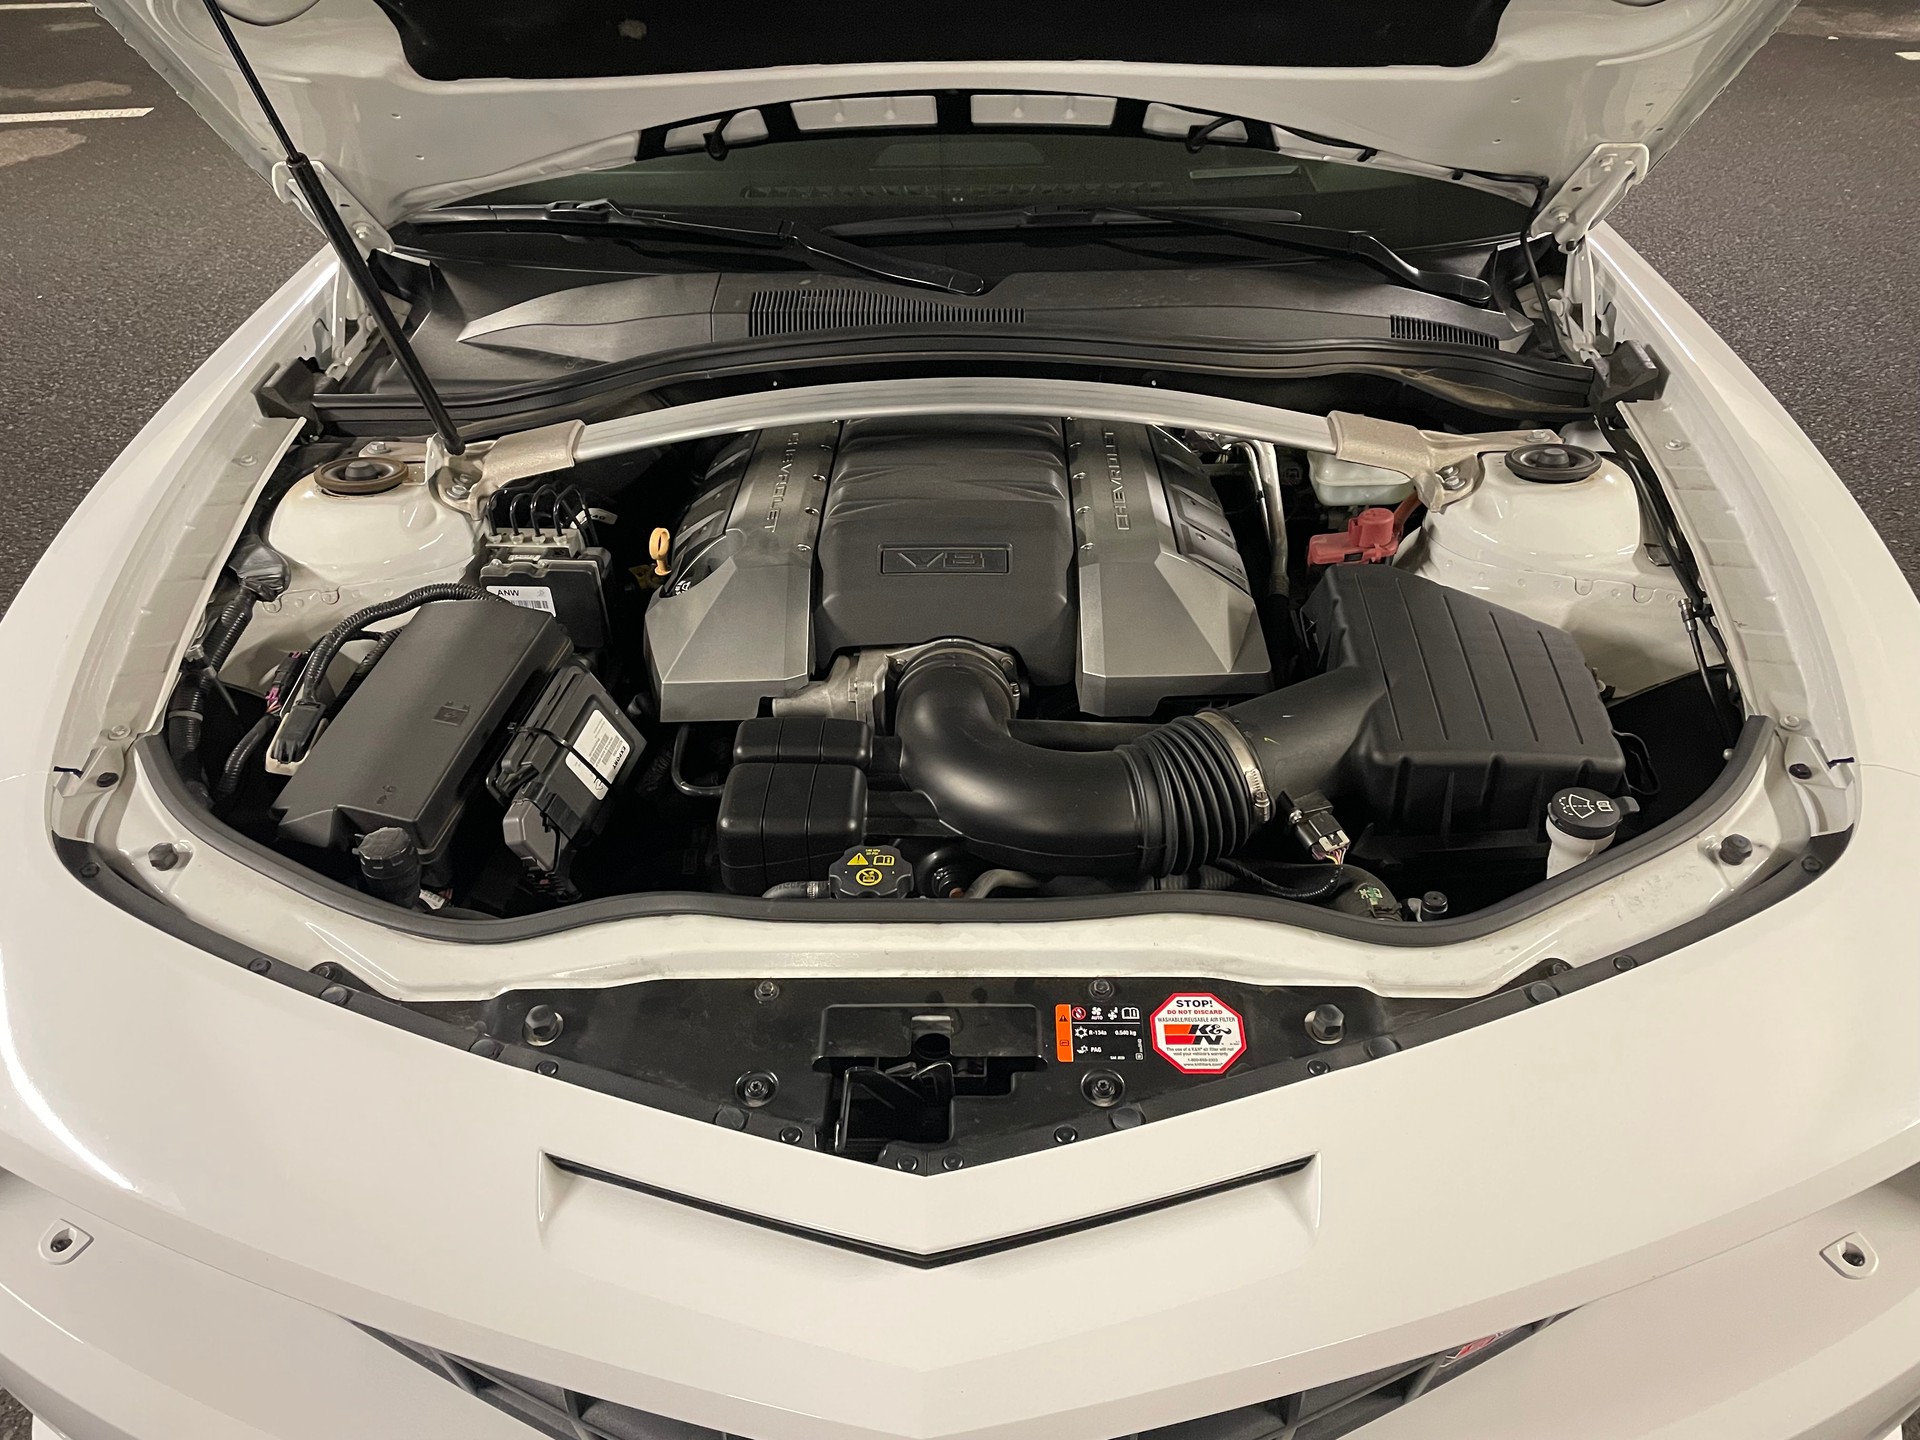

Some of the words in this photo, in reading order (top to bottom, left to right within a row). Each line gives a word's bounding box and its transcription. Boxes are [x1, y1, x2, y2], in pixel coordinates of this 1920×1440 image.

[764, 432, 799, 533] CHEVROLET
[1102, 427, 1130, 531] CHEVROLET
[897, 551, 985, 569] V8
[612, 745, 626, 770] EXPORT
[1176, 999, 1213, 1008] STOP!
